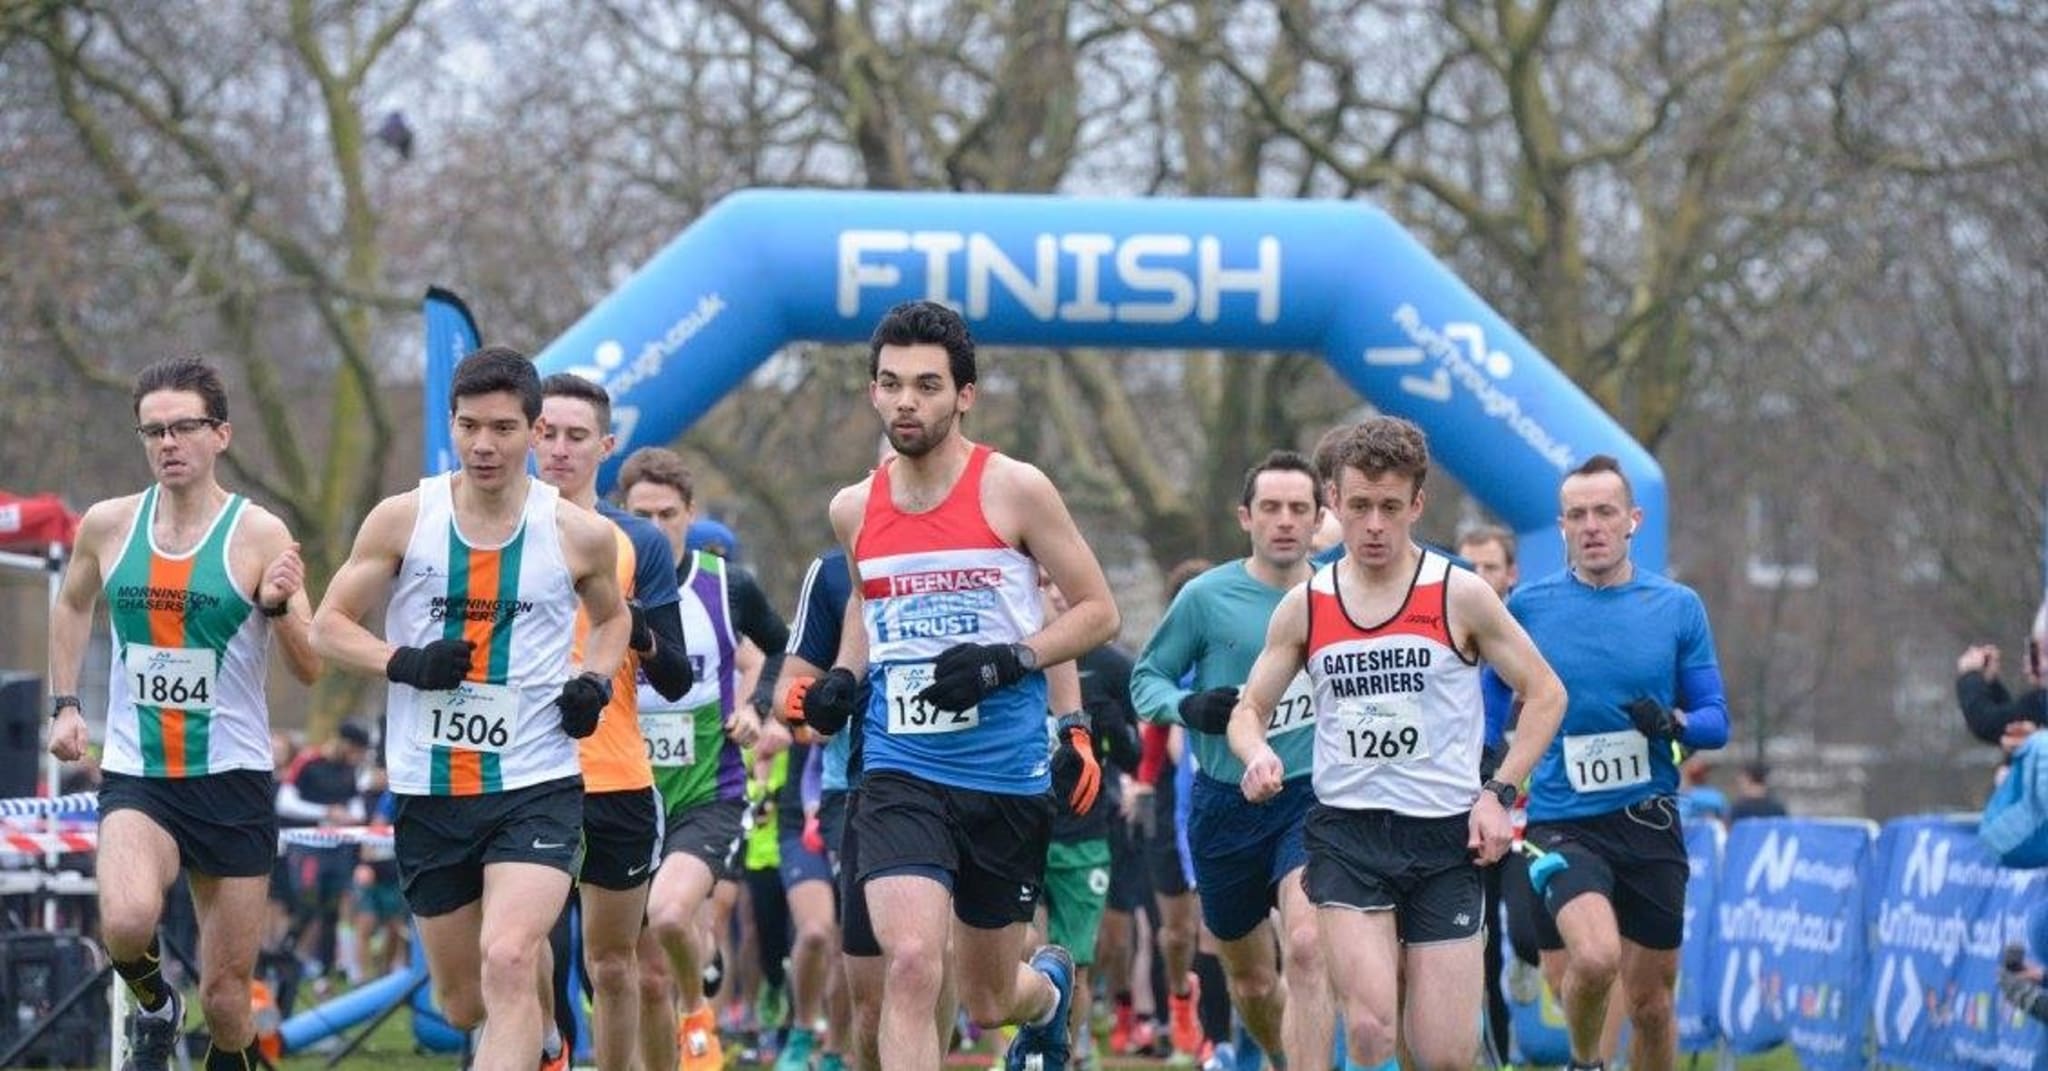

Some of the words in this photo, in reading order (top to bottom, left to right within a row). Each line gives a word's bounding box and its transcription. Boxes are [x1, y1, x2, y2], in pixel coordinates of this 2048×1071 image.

[836, 229, 1282, 324] FINISH
[897, 570, 1002, 593] TEENAGE
[117, 586, 221, 609] MORNINGTON
[117, 599, 185, 612] CHASERS
[901, 614, 978, 637] TRUST
[1323, 647, 1432, 676] GATESHEAD
[136, 673, 209, 703] 1864
[1331, 672, 1426, 698] HARRIERS
[431, 709, 509, 747] 1506
[1347, 726, 1419, 759] 1269
[1576, 754, 1640, 786] 1011
